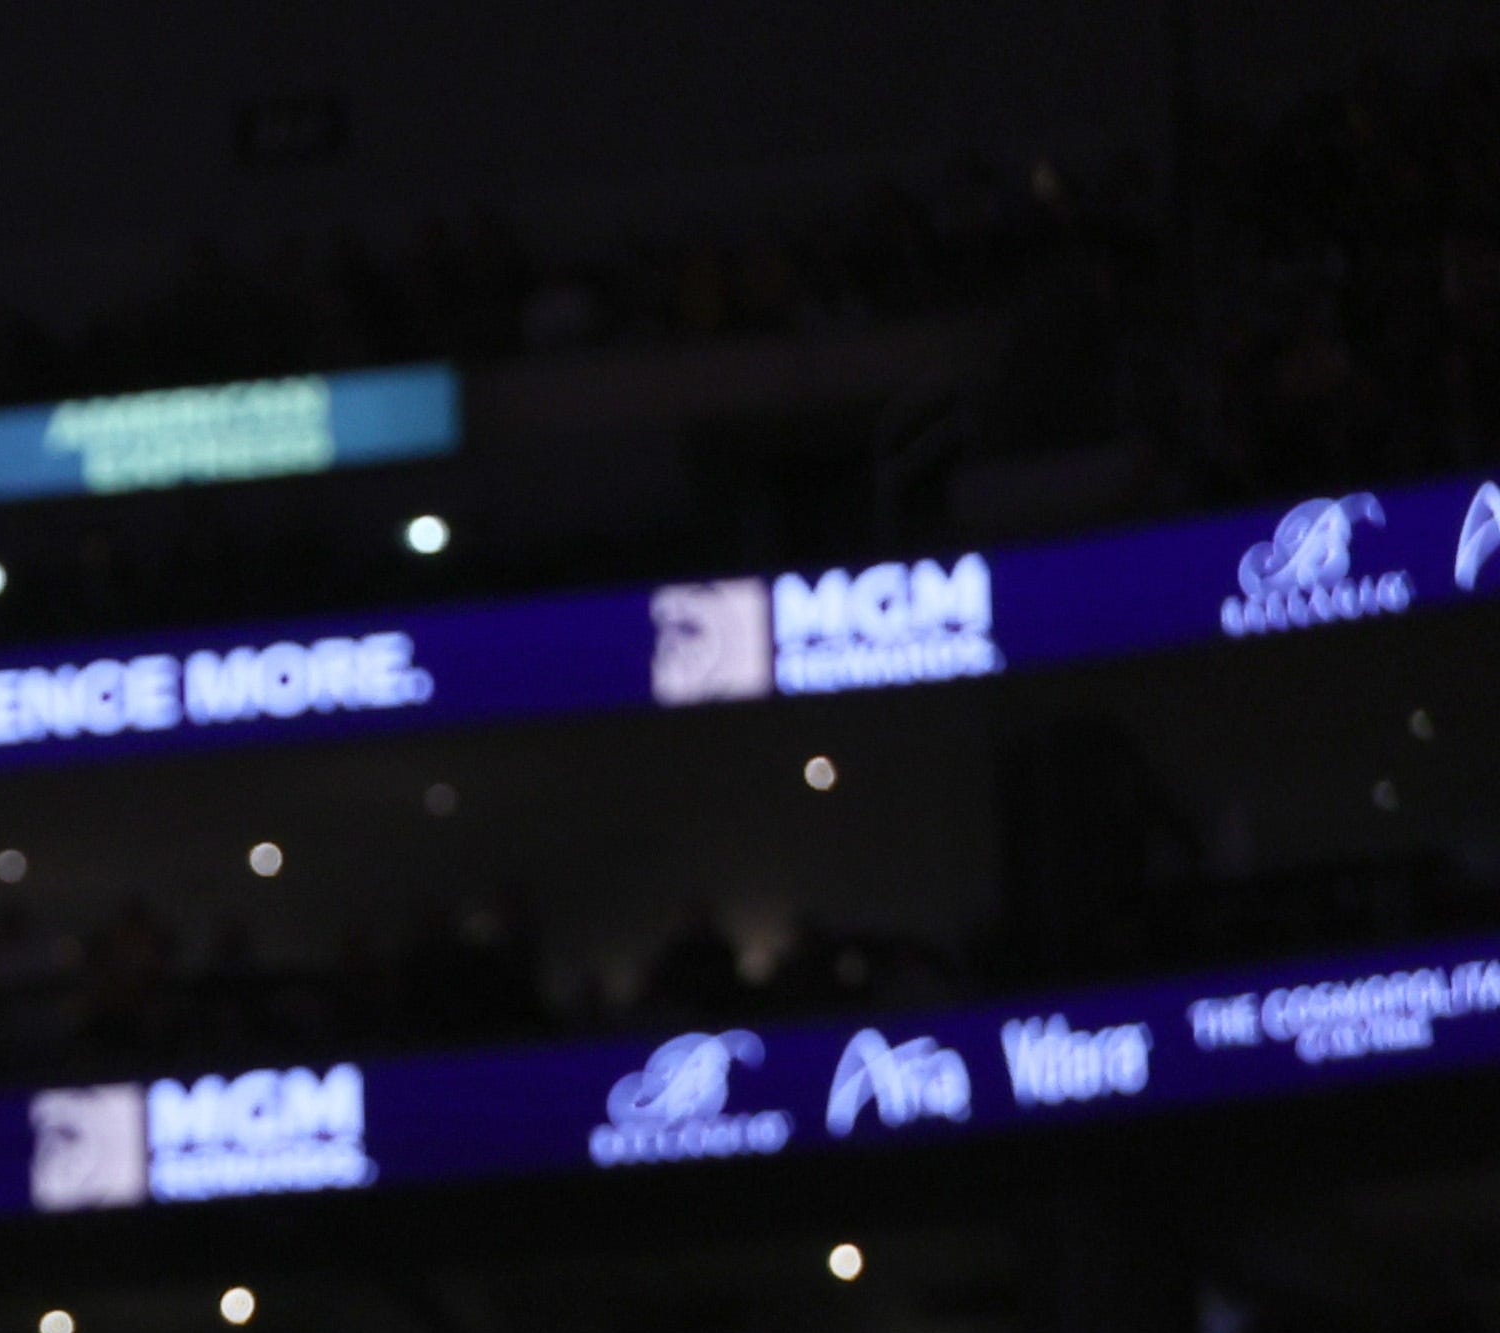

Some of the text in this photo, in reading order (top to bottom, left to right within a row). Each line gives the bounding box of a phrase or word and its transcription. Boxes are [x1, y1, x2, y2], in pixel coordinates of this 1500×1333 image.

[772, 552, 991, 642] MGM
[183, 632, 434, 720] MORE.
[147, 1061, 364, 1150] MGM
